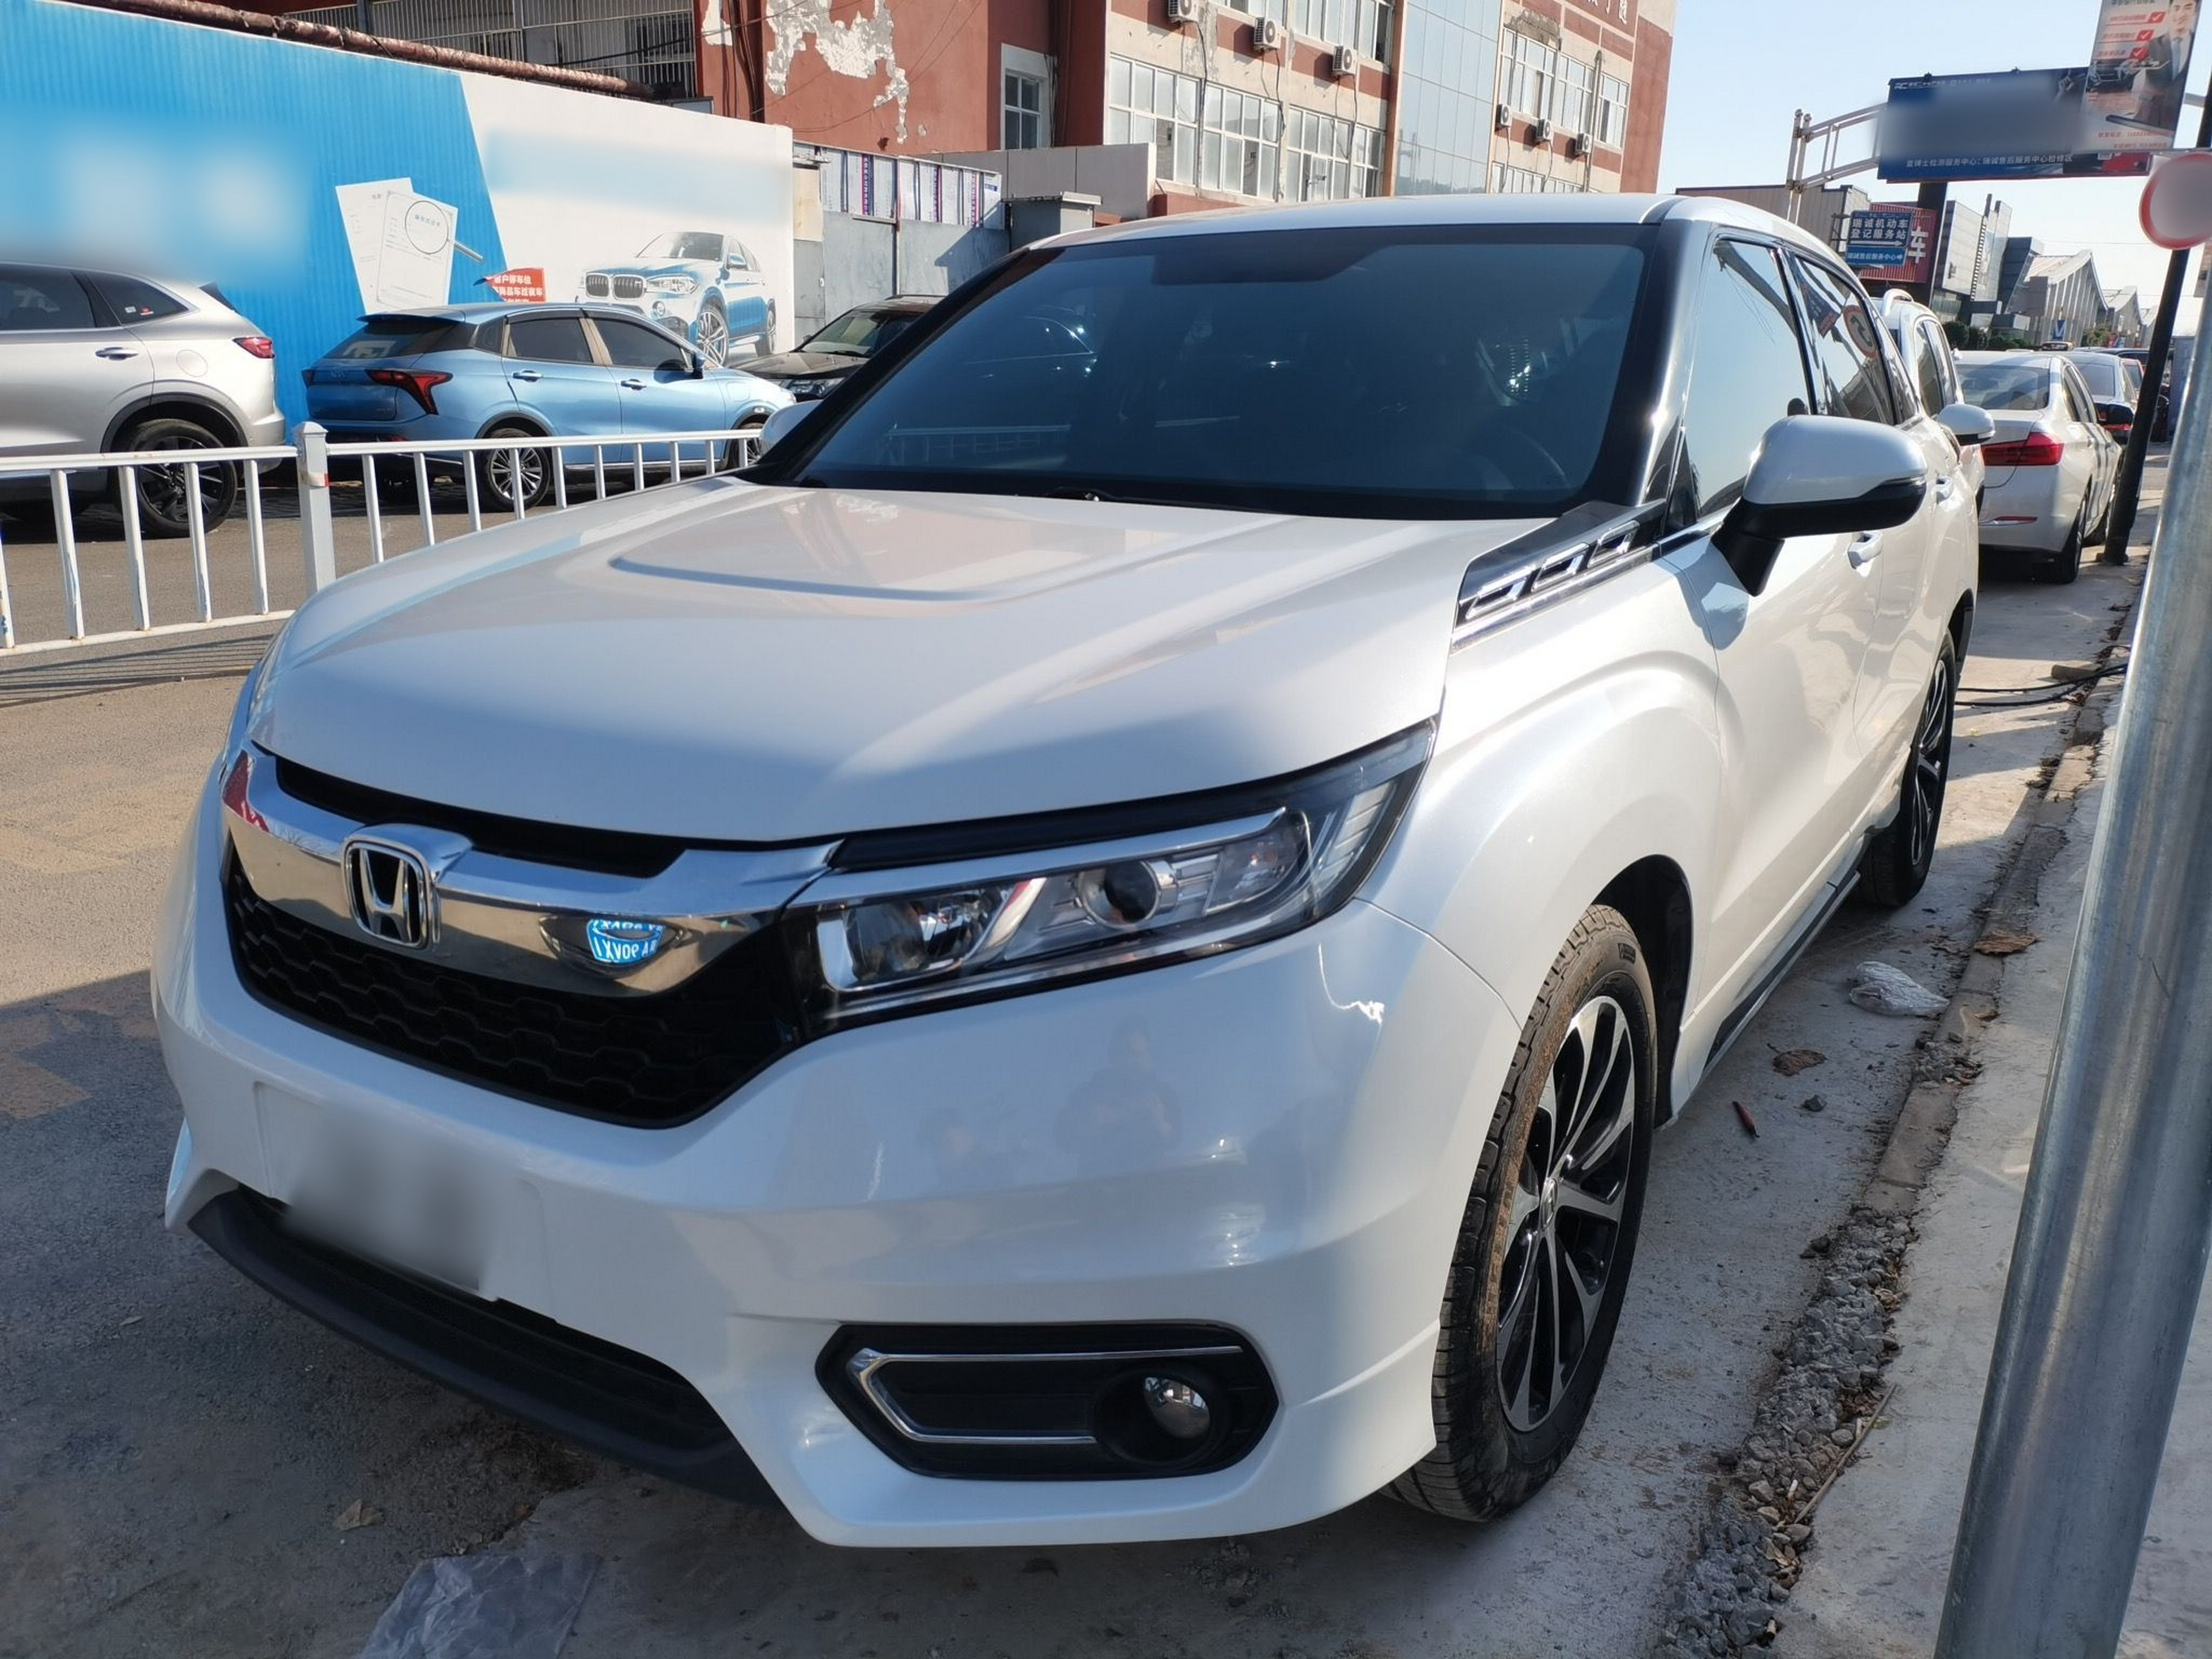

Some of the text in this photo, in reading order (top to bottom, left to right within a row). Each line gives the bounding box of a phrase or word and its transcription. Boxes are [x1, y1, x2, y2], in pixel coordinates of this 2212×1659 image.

[1851, 218, 1908, 229] 瑞诚机动车
[1850, 229, 1906, 239] 登记服务站
